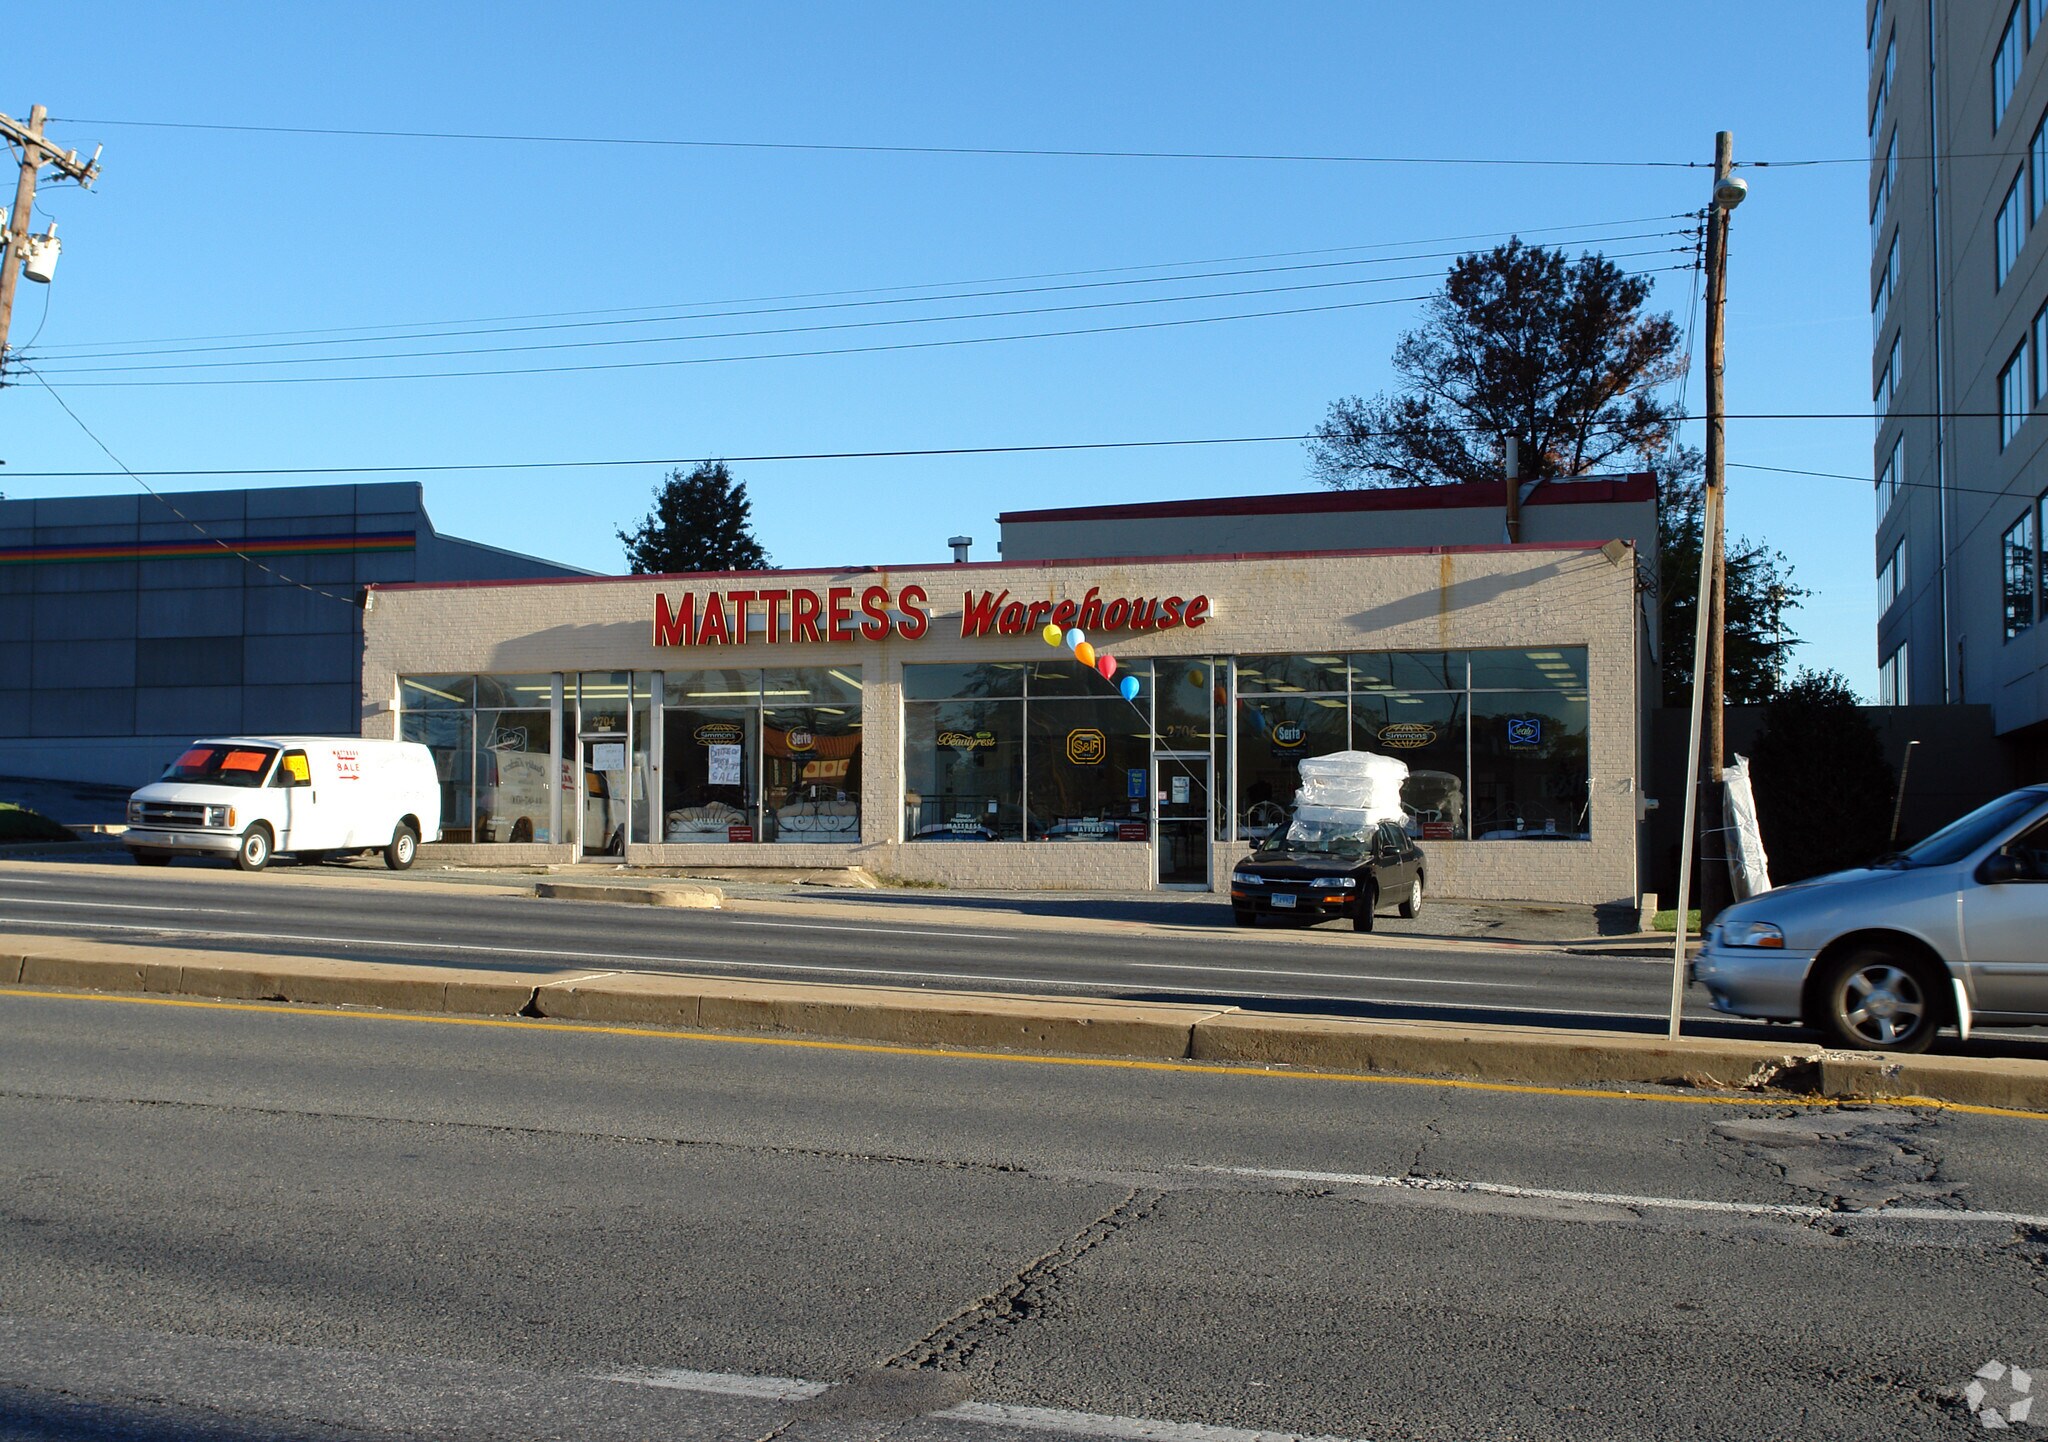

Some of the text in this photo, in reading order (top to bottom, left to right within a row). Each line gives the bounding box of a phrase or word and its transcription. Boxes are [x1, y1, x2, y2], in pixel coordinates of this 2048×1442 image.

[653, 585, 1209, 646] MATTRESS Warehouse
[592, 717, 616, 727] 2704
[792, 732, 811, 744] Serta
[1279, 727, 1300, 740] Serta
[937, 732, 996, 751] Beautyrest
[1074, 740, 1099, 753] S&F
[337, 763, 359, 771] SALE
[712, 772, 739, 782] SALE
